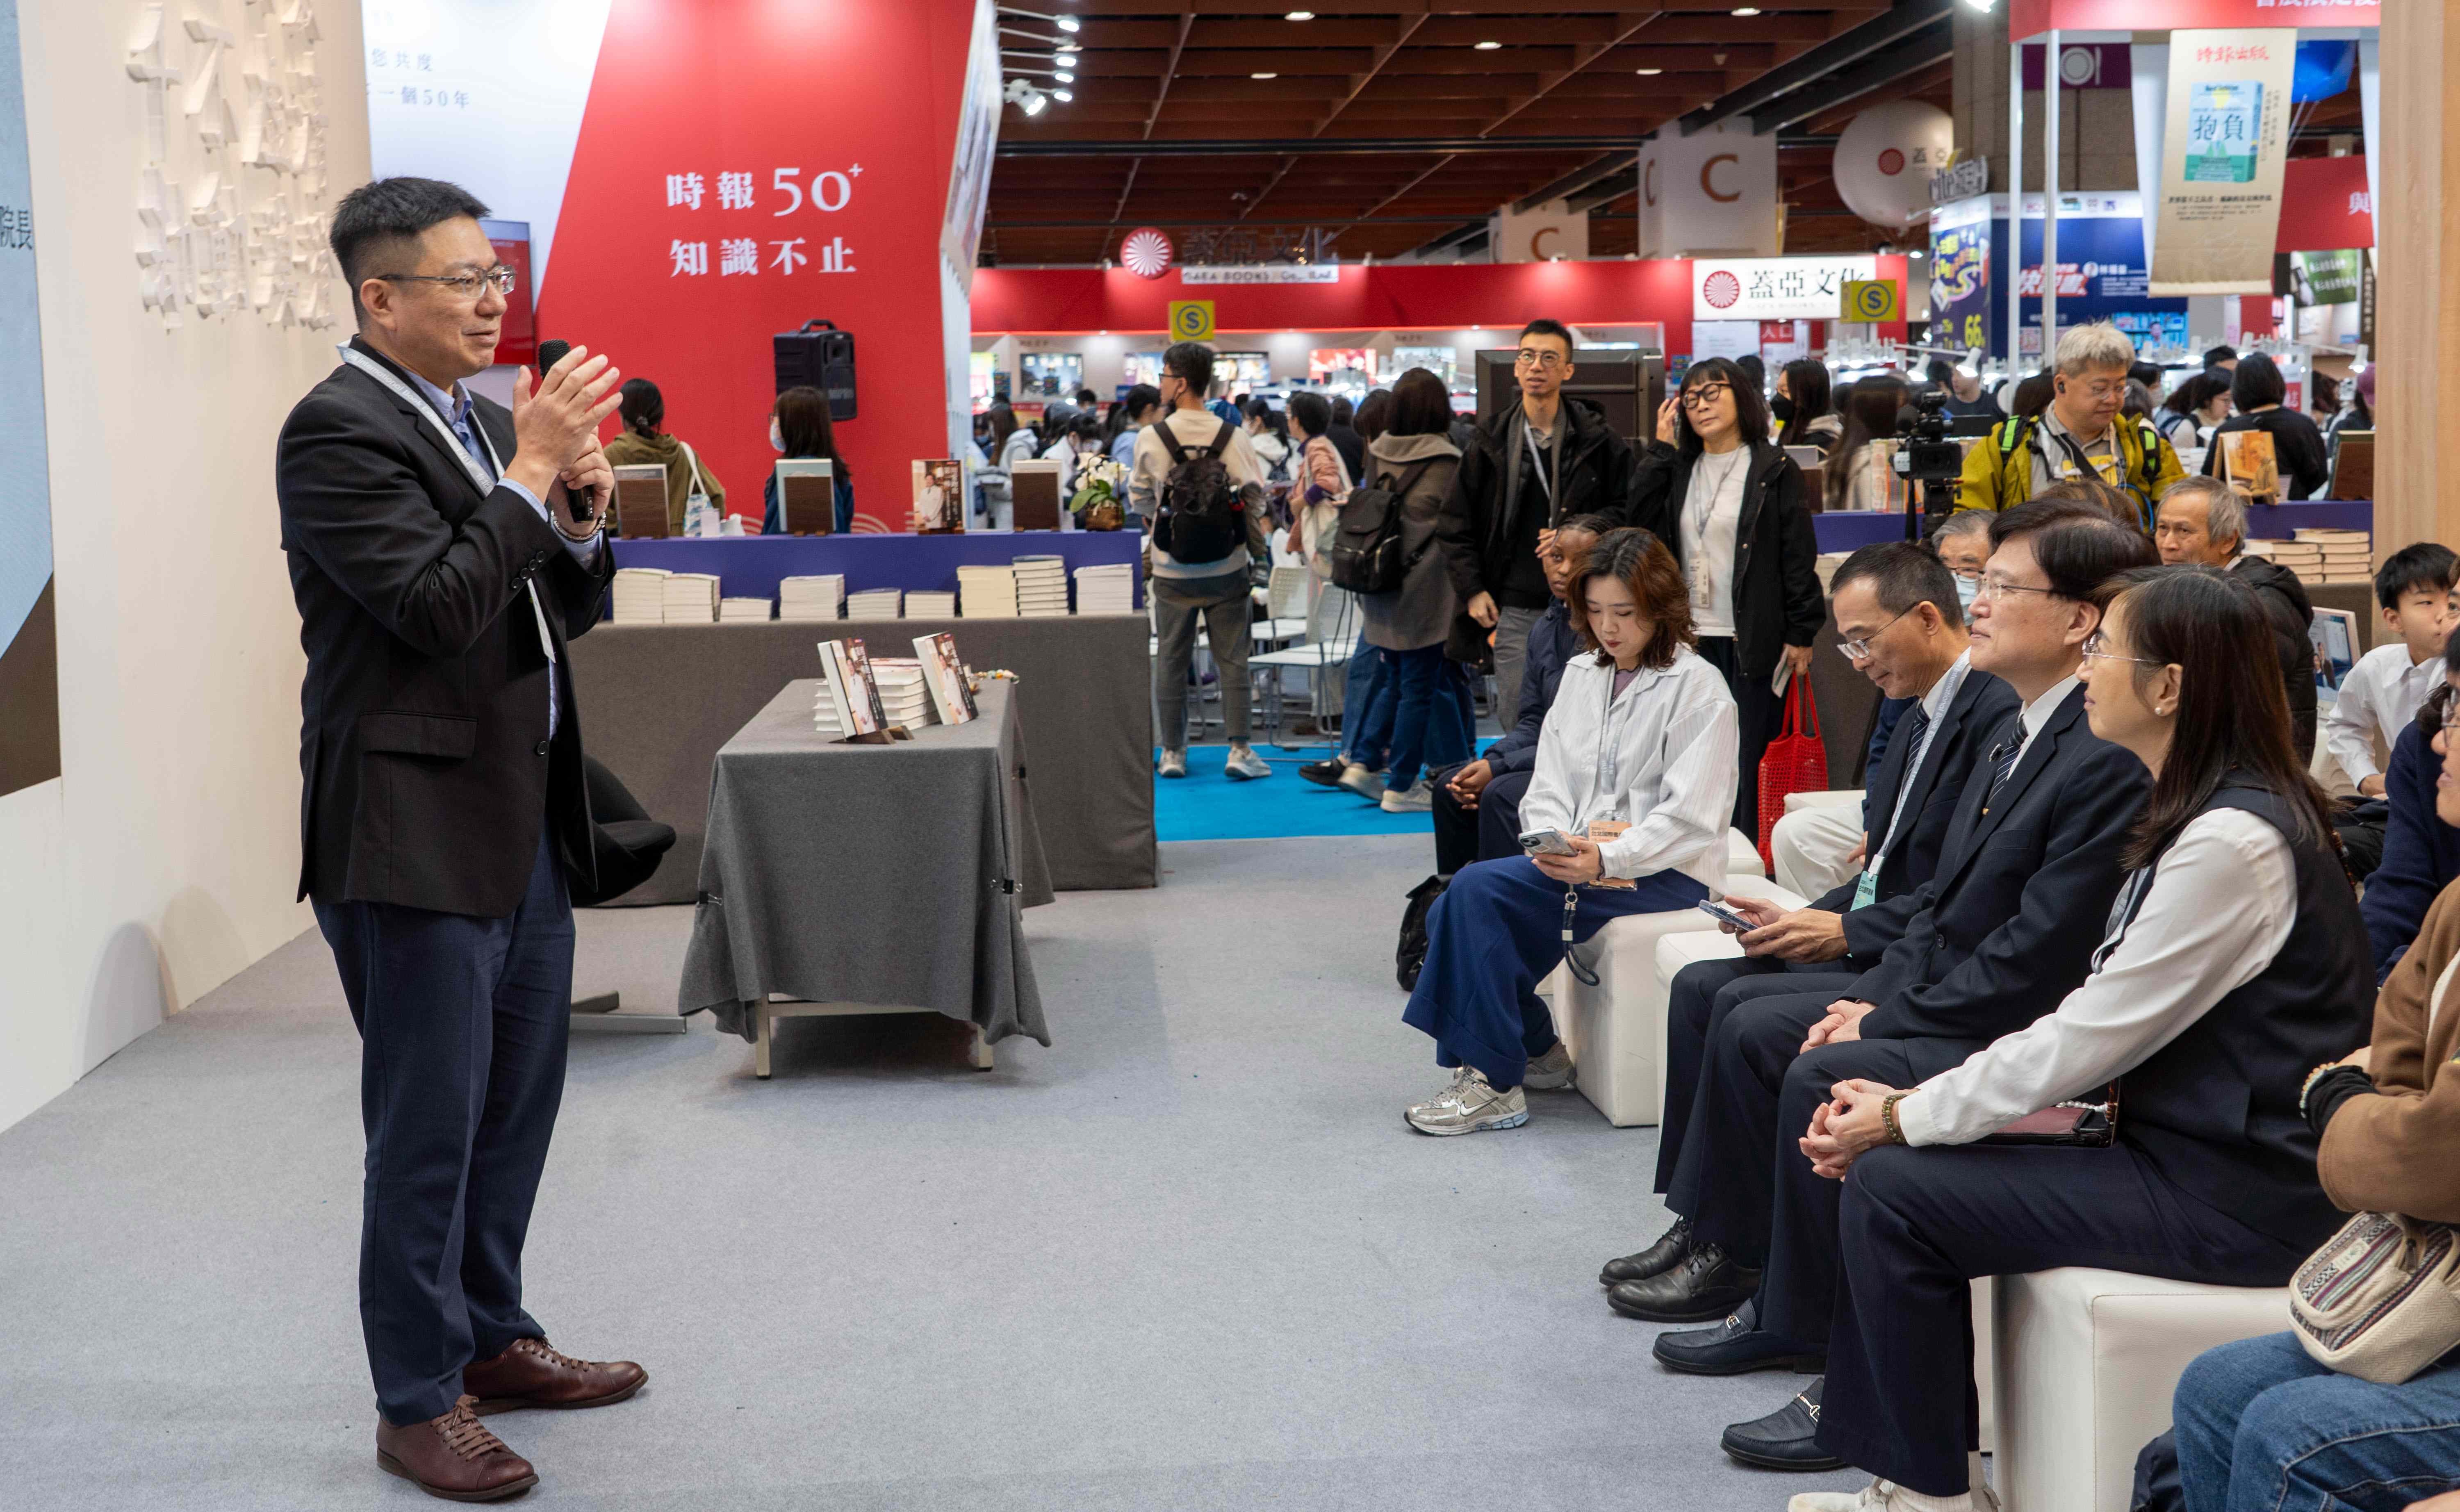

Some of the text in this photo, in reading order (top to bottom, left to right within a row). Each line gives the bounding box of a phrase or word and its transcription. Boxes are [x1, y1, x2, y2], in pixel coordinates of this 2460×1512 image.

[366, 83, 469, 110] 一個50年
[2194, 114, 2244, 141] 抱負
[1701, 153, 1741, 203] C
[670, 237, 857, 278] 知識不止
[1931, 712, 1945, 729] Book
